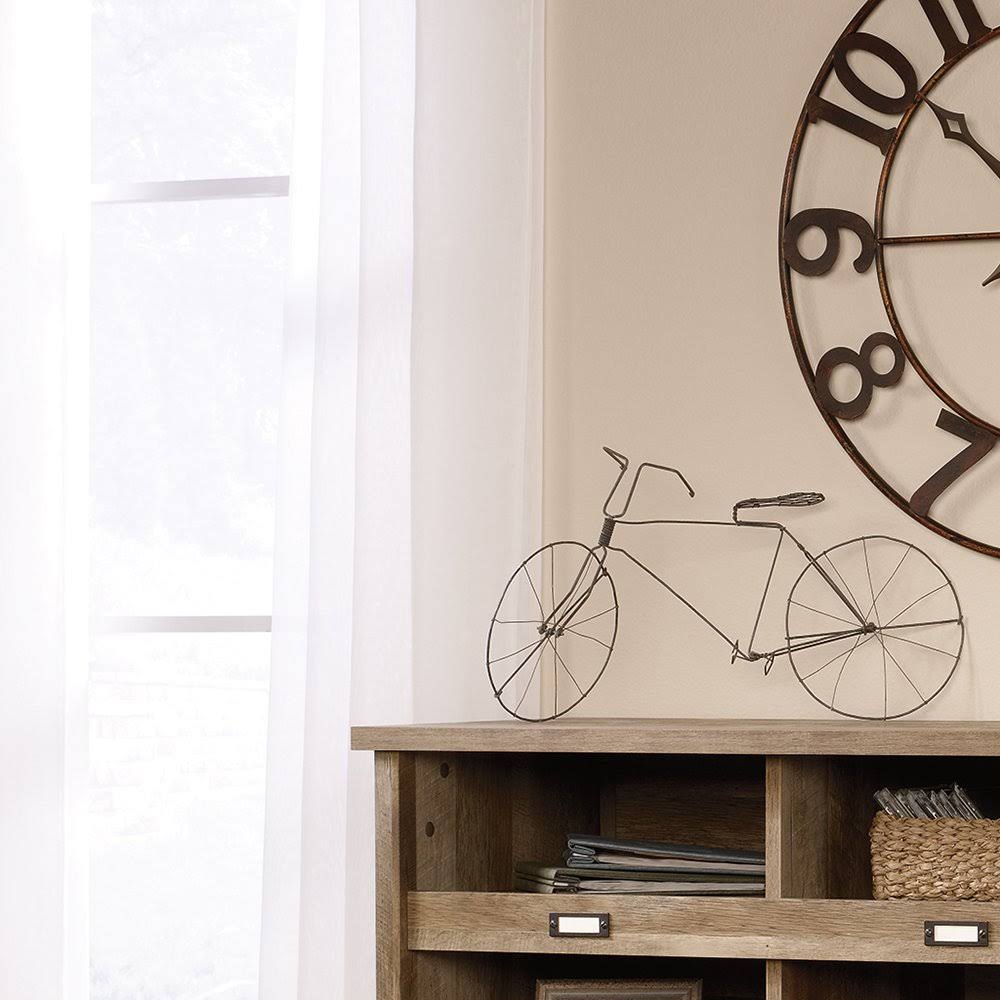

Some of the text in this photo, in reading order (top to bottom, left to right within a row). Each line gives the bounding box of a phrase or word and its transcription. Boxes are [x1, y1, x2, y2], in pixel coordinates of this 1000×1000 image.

[807, 32, 918, 156] 10
[783, 208, 879, 276] 9
[814, 332, 906, 421] 8
[909, 408, 999, 517] 7
